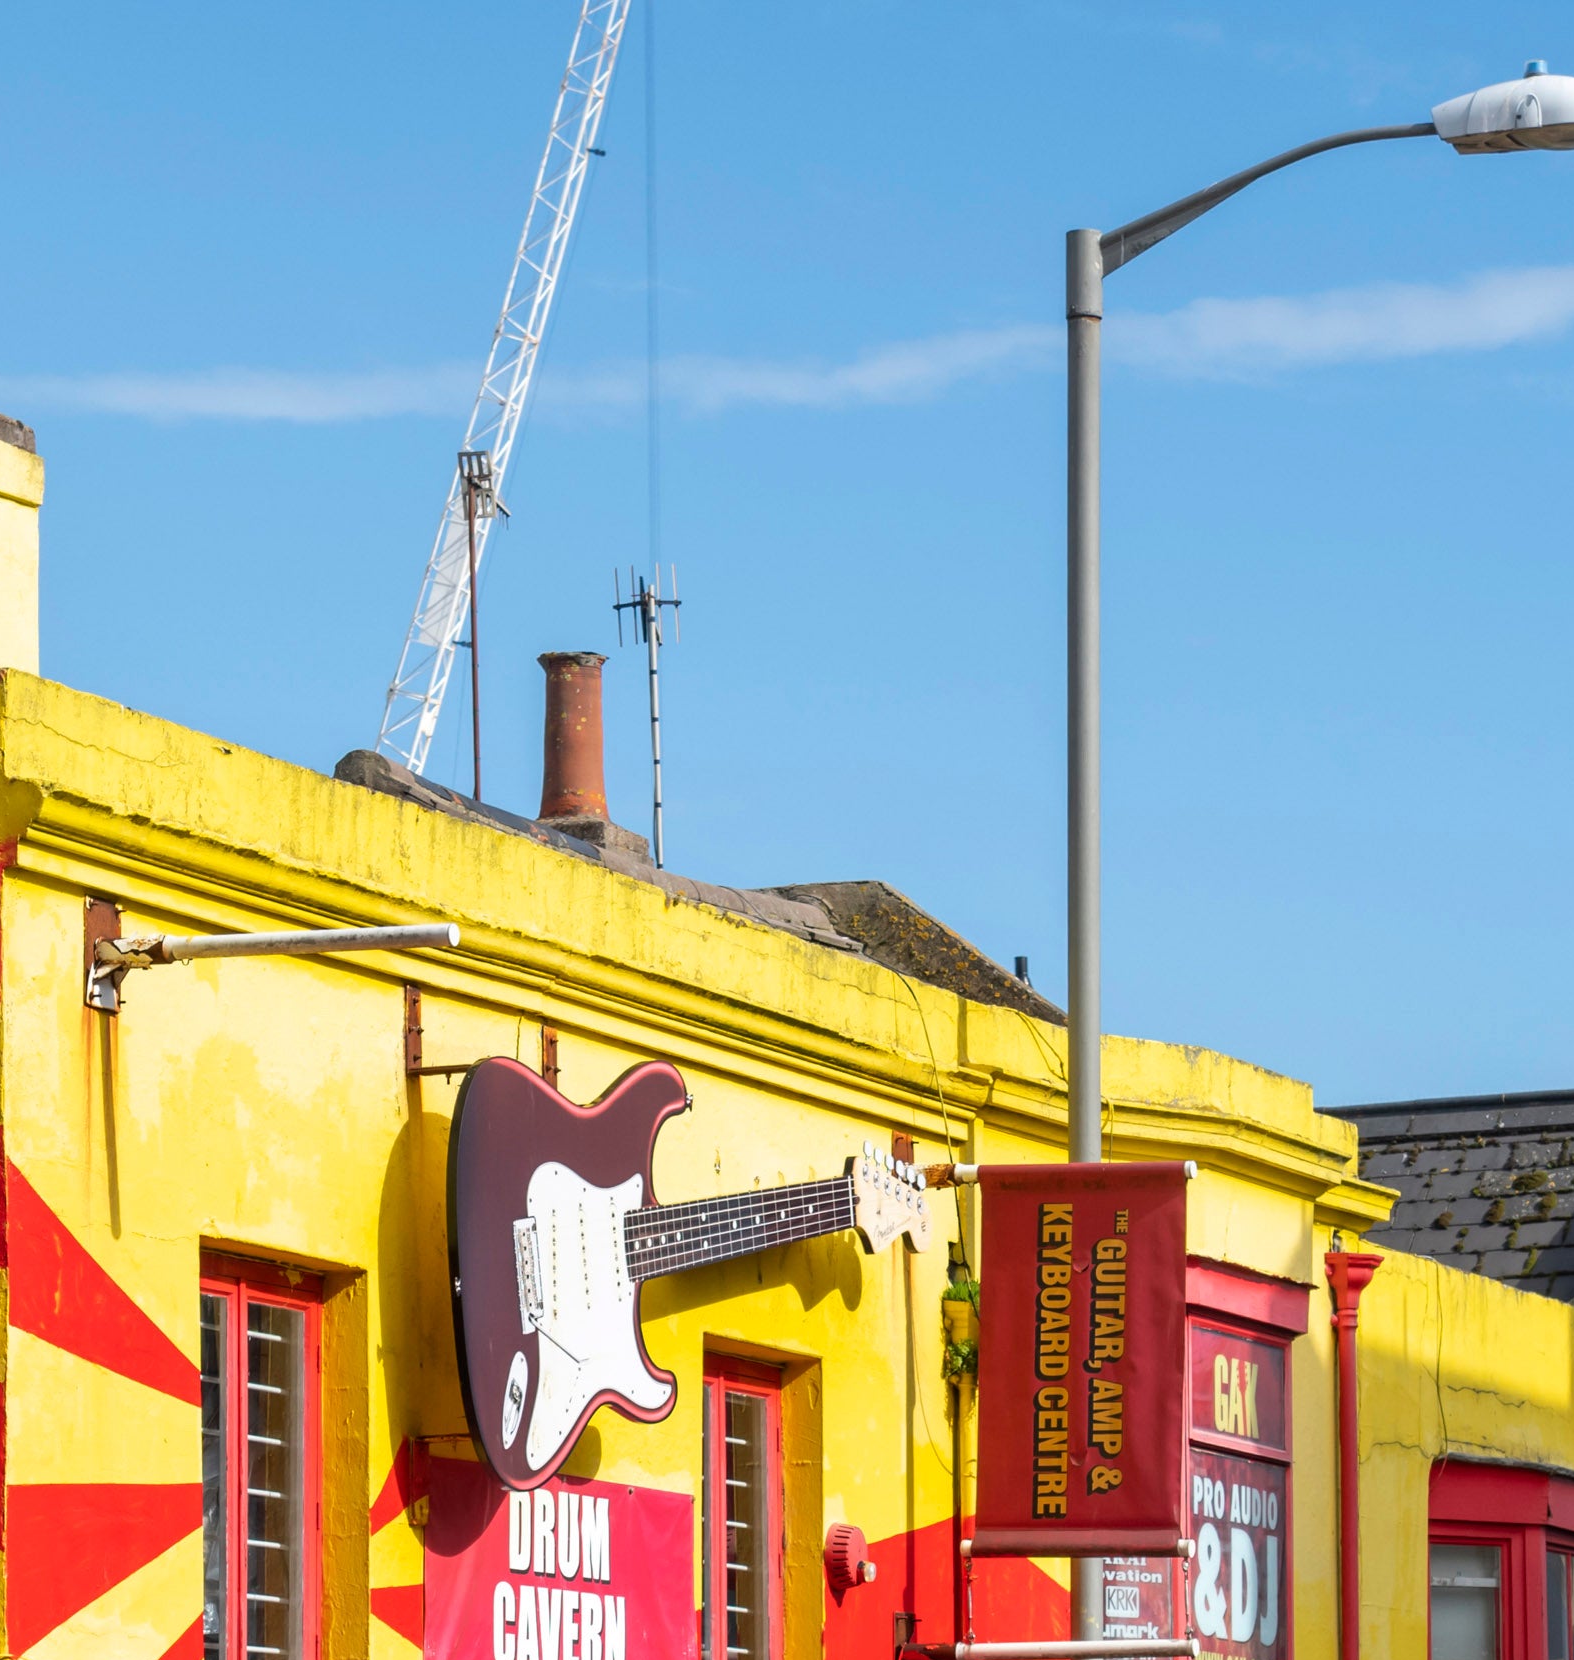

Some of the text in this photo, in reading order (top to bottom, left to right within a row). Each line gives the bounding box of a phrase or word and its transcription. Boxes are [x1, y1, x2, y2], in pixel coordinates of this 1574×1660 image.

[1031, 1203, 1073, 1520] KEYBOARD CENTRE
[1084, 1208, 1129, 1495] THE GUITAR, AMP &
[1213, 1353, 1260, 1440] GAK
[509, 1488, 611, 1585] DRUM
[1192, 1475, 1278, 1532] PRO AUDIO
[1102, 1569, 1163, 1584] vation
[1106, 1587, 1138, 1612] KRK
[1193, 1522, 1279, 1647] & DJ
